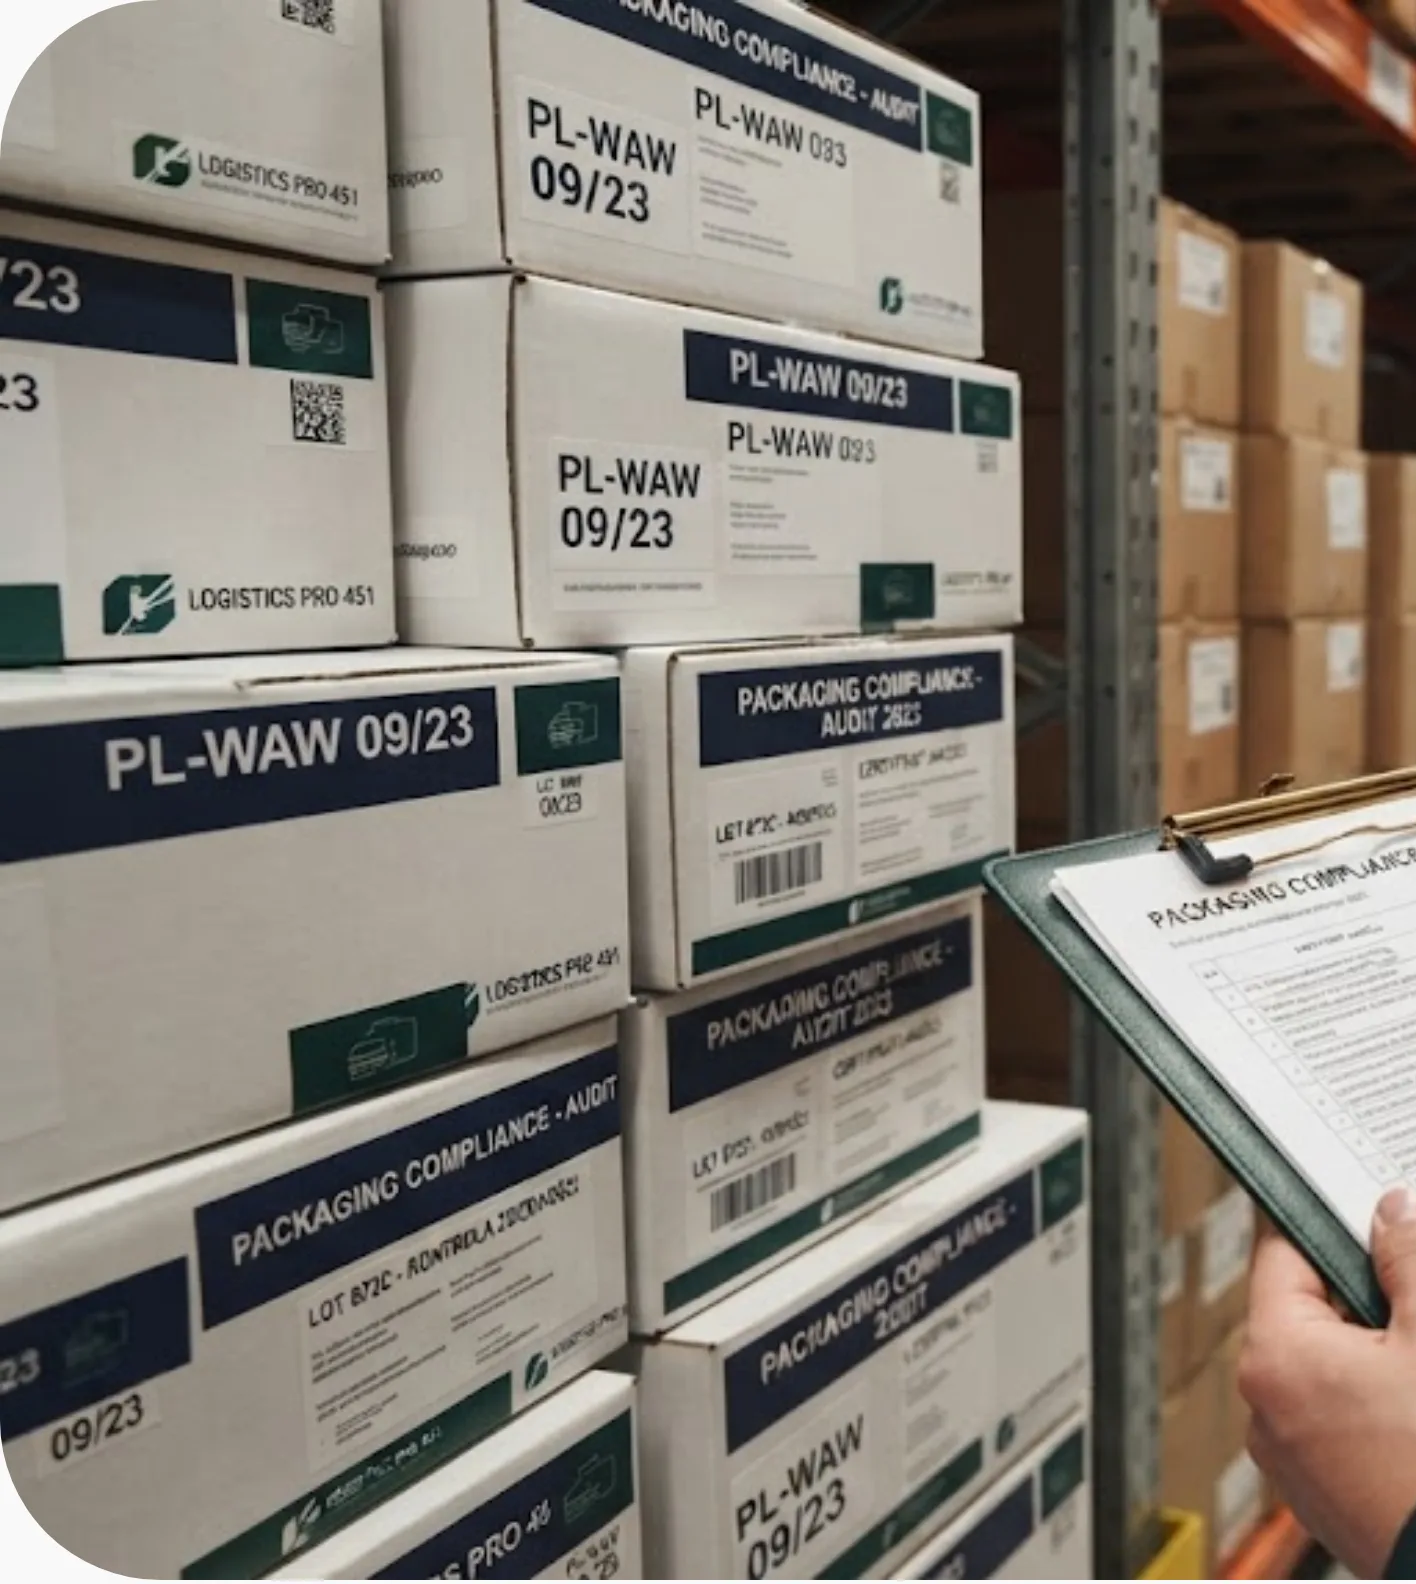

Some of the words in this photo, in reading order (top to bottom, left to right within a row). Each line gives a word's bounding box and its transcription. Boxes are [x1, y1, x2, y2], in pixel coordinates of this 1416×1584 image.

[527, 97, 677, 177] PL-WAW
[694, 86, 804, 153] PL-WAW
[328, 184, 359, 207] 451
[530, 154, 650, 223] 09/23
[729, 348, 843, 399] PL-WAW
[727, 421, 834, 459] PL-WAW
[558, 453, 701, 498] PL-WAW
[560, 506, 673, 552] 09/23
[188, 588, 296, 612] LOGISTICS
[300, 586, 338, 608] PRO
[342, 585, 375, 606] 451
[737, 676, 861, 717] PACKAGING
[820, 705, 879, 739] AUDIT
[105, 717, 342, 792] PL-WAW
[356, 704, 475, 759] 09/23
[231, 1171, 400, 1267] PACKAGING
[405, 1104, 551, 1189] COMPLIANCE
[565, 1073, 618, 1122] AUDIT
[308, 1292, 346, 1329] LOT
[51, 1393, 144, 1462] 09/23
[735, 1414, 865, 1544] PL-WAW
[467, 1521, 522, 1580] PRO
[747, 1477, 847, 1580] 09/23
